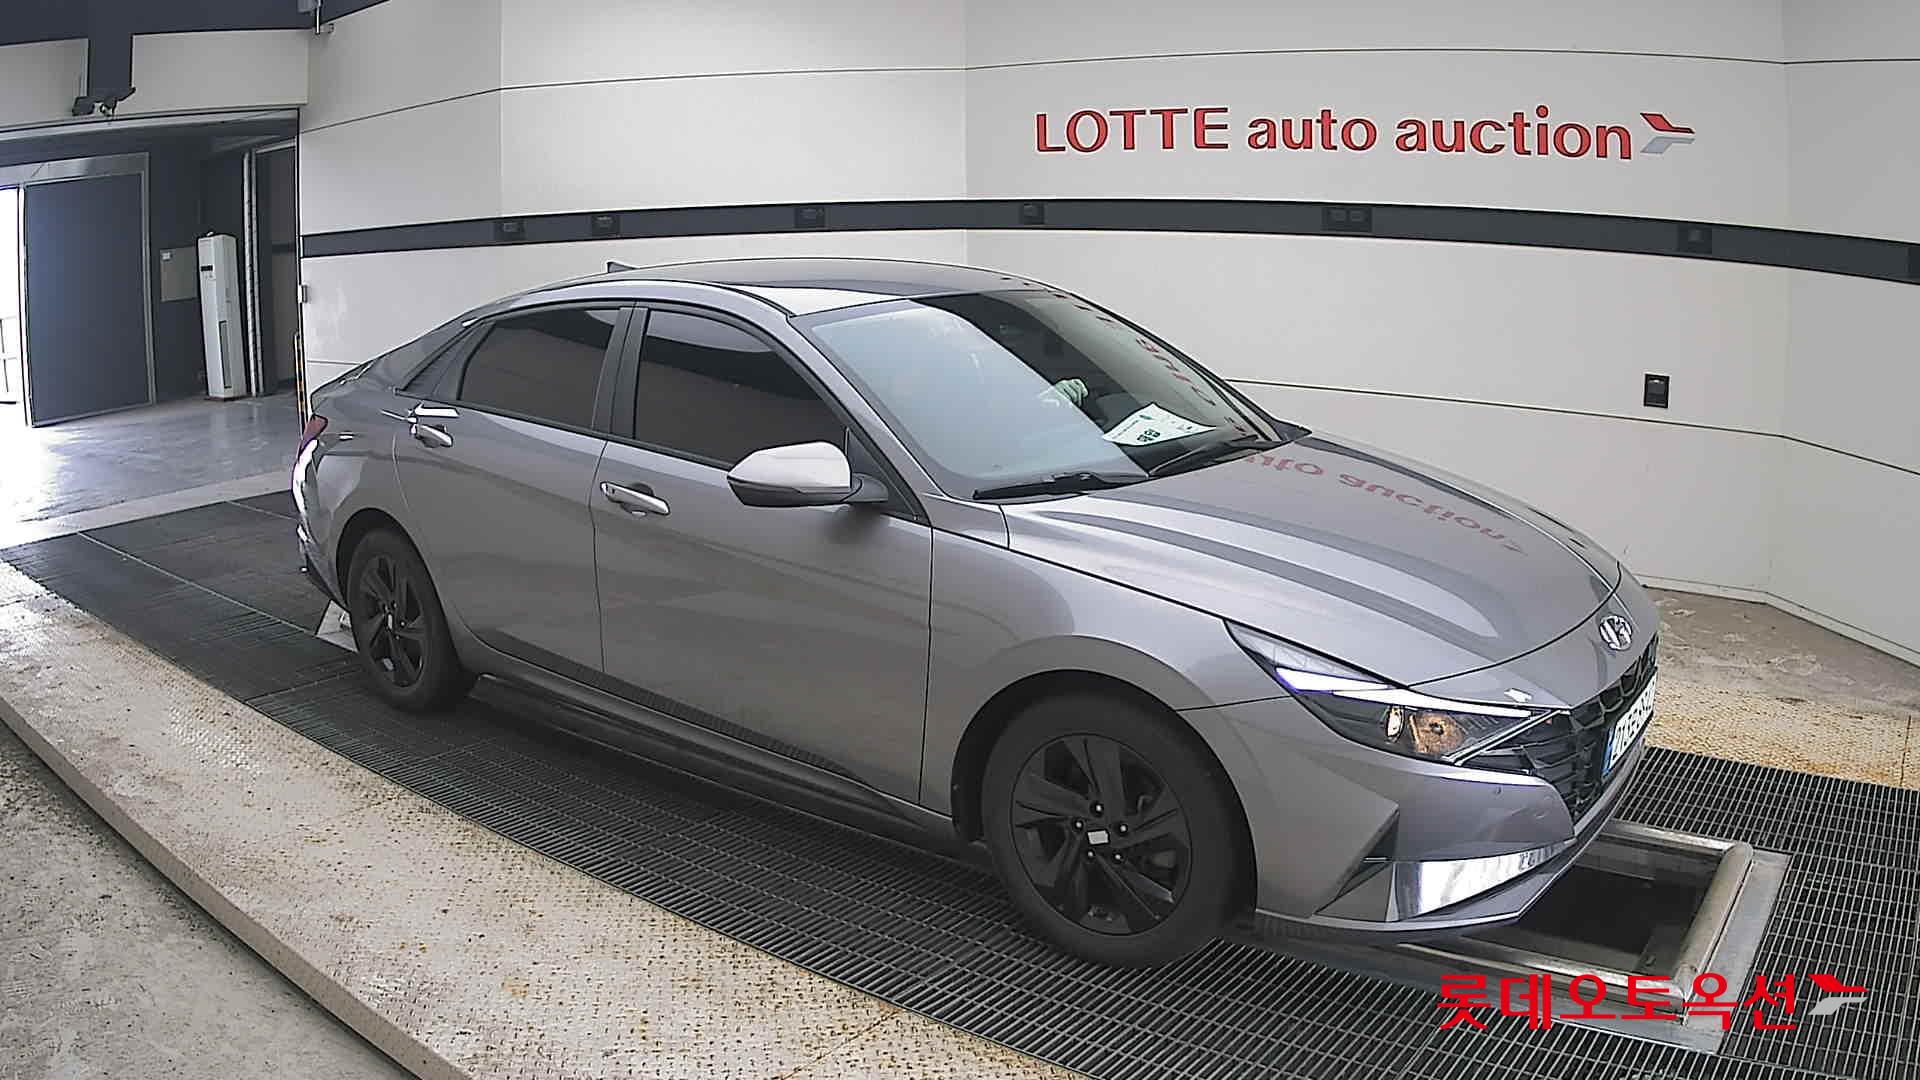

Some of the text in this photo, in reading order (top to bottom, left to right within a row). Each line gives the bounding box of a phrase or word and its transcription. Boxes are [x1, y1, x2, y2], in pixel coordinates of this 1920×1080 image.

[1036, 105, 1633, 160] LOTTE auto auction
